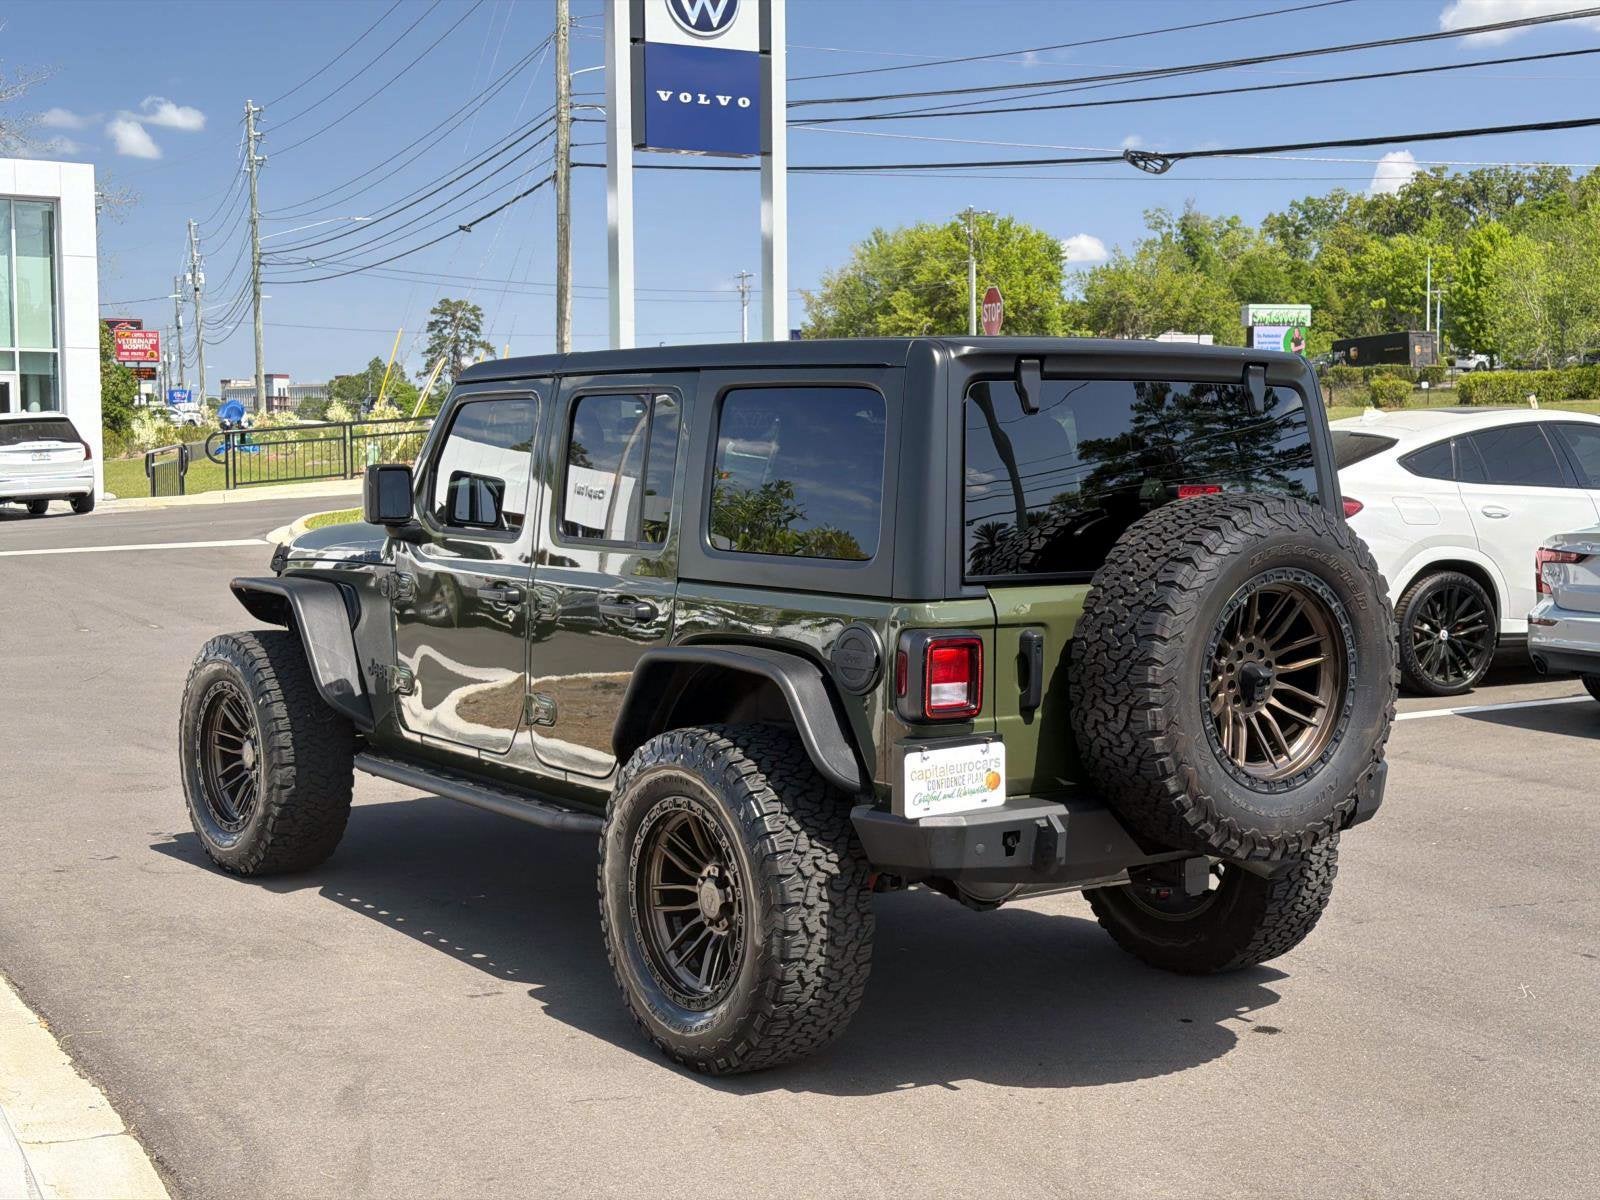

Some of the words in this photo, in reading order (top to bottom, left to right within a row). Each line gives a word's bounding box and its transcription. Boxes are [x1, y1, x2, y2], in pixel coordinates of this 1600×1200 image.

[656, 90, 751, 109] VOLVO
[983, 302, 1001, 323] STOP
[368, 658, 388, 683] Jeep
[910, 757, 1001, 782] capitaleurocars
[927, 774, 966, 791] CONFIDENCE
[967, 772, 984, 785] PLAN
